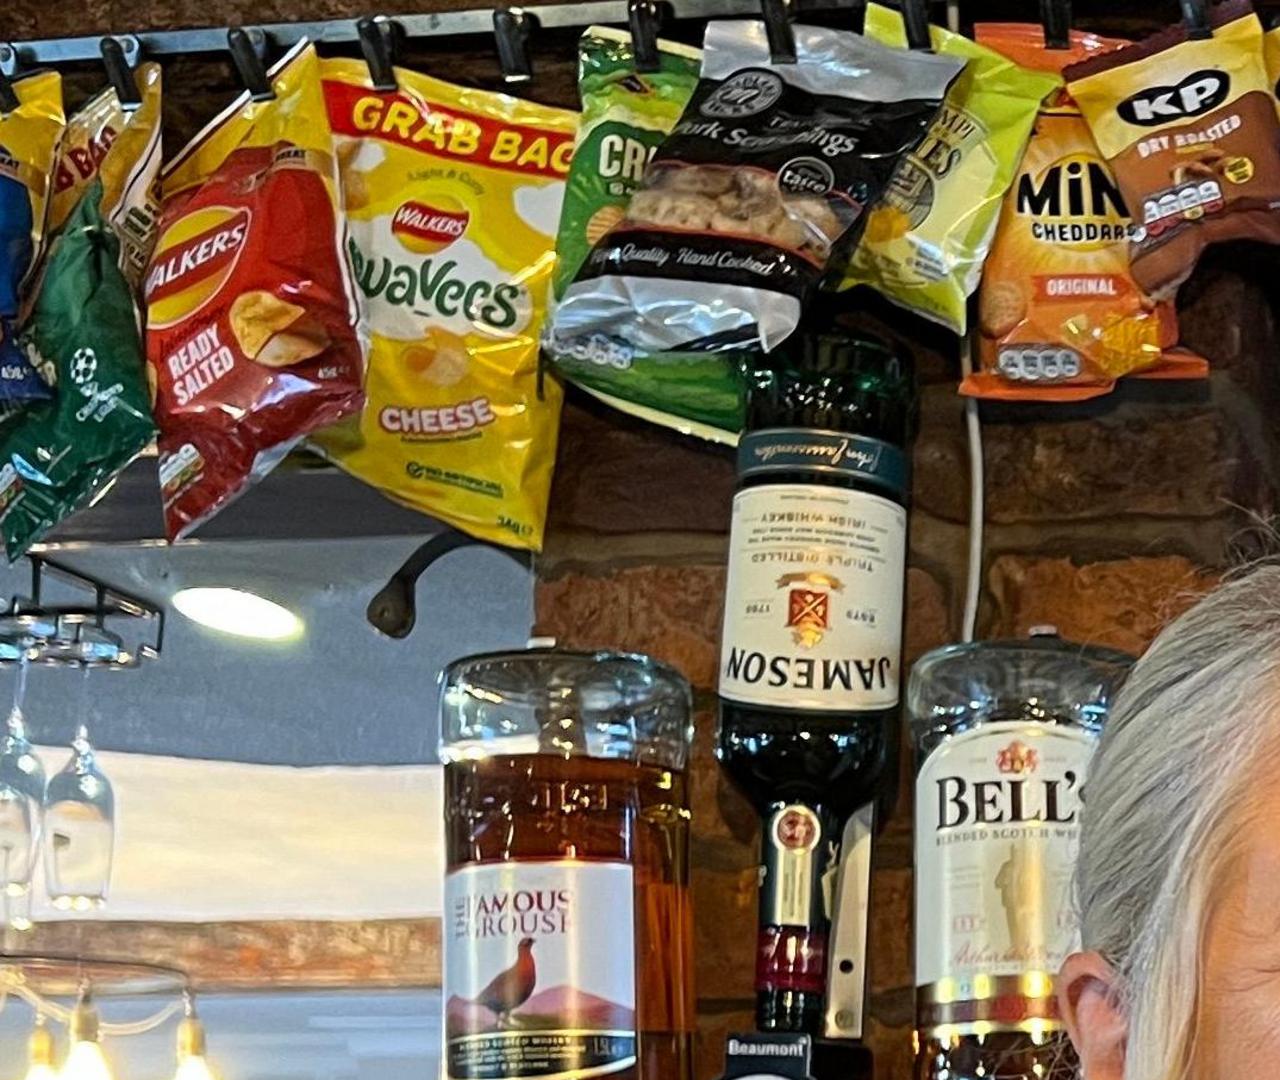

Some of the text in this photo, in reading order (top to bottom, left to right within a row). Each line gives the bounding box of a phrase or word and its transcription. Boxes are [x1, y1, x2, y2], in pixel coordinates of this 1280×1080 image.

[1133, 77, 1221, 121] KP
[353, 96, 482, 154] GRAB
[1137, 115, 1242, 158] DRY ROASTED
[395, 206, 467, 236] WALKERS
[622, 243, 670, 265] Quality
[676, 247, 717, 267] Hand
[1047, 279, 1117, 296] ORIGINAL
[167, 323, 222, 380] READY
[172, 346, 235, 405] SALTED
[379, 397, 496, 434] CHEESE
[760, 511, 824, 526] WHISKEY
[824, 554, 874, 572] TRIPLE
[726, 646, 891, 692] JAMESON
[936, 771, 1086, 831] BELL'
[728, 1039, 805, 1057] Beaumont
